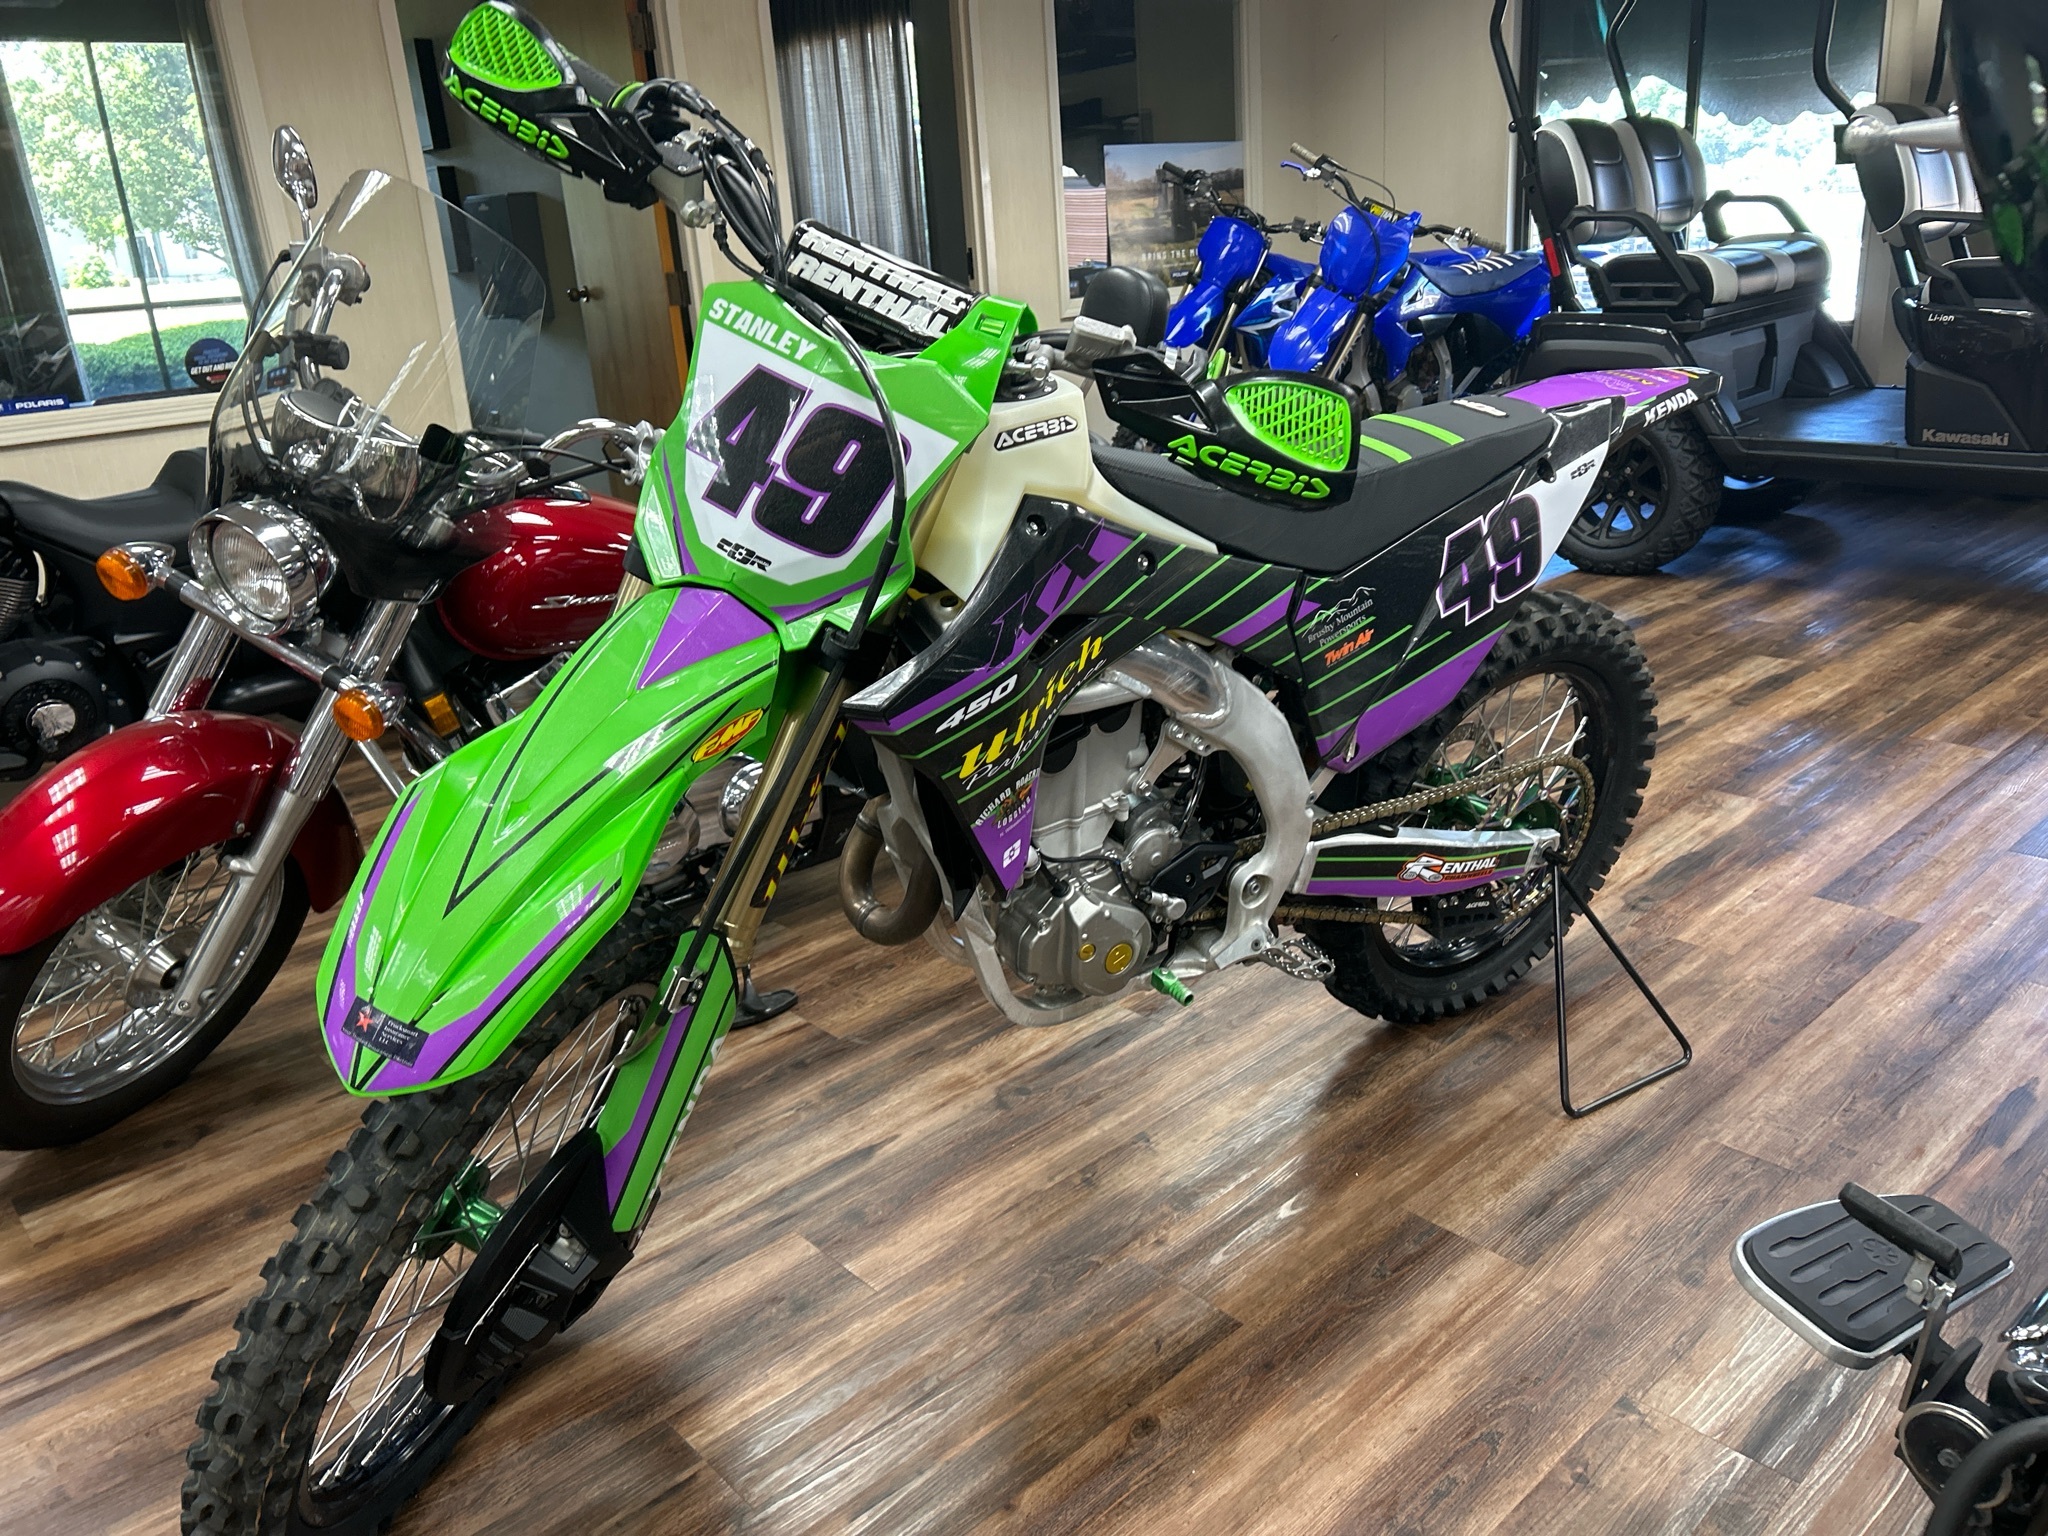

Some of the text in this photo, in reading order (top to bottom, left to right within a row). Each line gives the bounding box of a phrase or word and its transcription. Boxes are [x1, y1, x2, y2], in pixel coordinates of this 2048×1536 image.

[1141, 251, 1167, 261] BRING
[1170, 249, 1186, 259] THE
[787, 252, 949, 339] RENTHAL
[708, 298, 818, 361] STANLEY
[190, 366, 202, 376] GET
[202, 364, 213, 373] OUT
[213, 363, 225, 372] AND
[15, 398, 65, 410] POLARIS
[1643, 388, 1699, 428] KENDA
[1921, 428, 2010, 447] Kawasaki
[686, 363, 912, 559] 49
[1435, 493, 1543, 627] 49
[1307, 598, 1374, 644] Brushy Mountain
[1319, 614, 1367, 647] Powersports
[1324, 641, 1355, 666] Twin
[1355, 628, 1375, 650] Air
[935, 674, 1019, 734] 450
[692, 707, 763, 764] FMF
[975, 787, 1012, 827] RICHARD
[1399, 856, 1498, 882] RENTHAL
